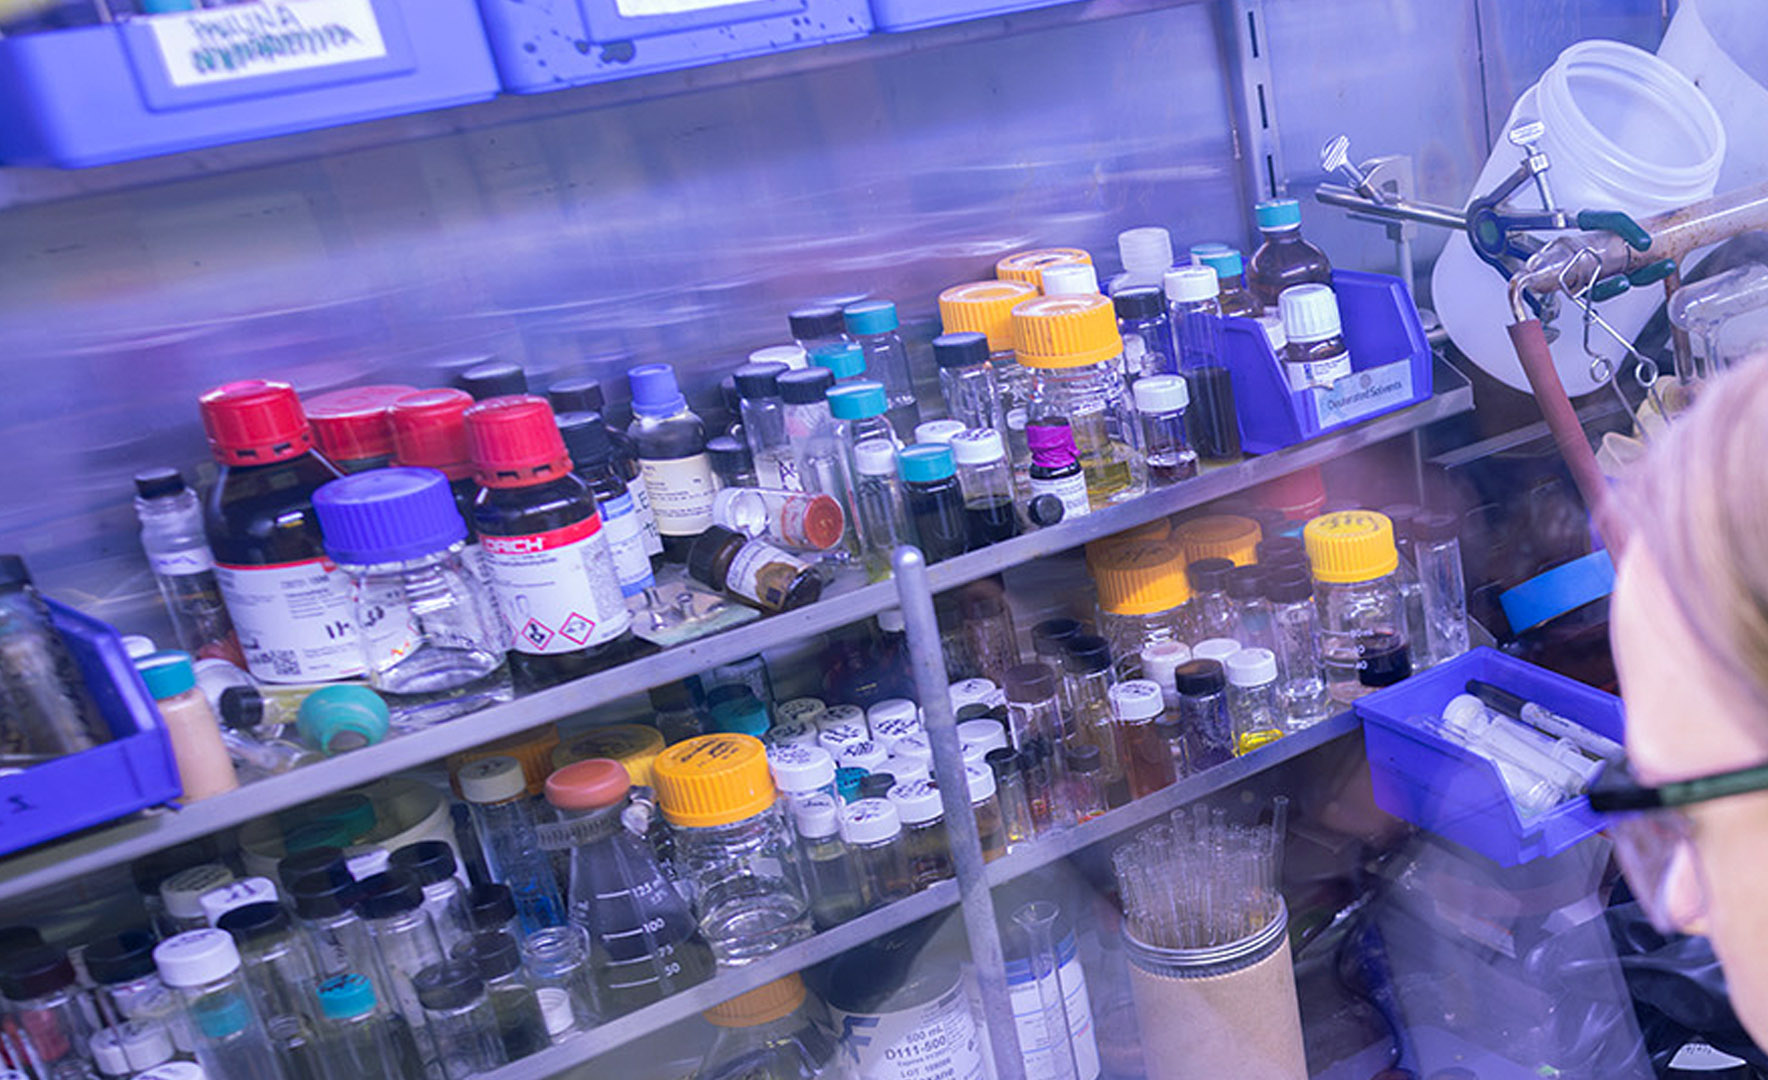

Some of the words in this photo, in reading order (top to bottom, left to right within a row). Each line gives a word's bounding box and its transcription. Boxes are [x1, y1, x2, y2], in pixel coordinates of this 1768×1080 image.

[643, 918, 665, 934] 100
[658, 944, 674, 958] 75
[664, 962, 680, 977] 50
[906, 1031, 926, 1043] 500
[884, 1035, 946, 1060] D111-500
